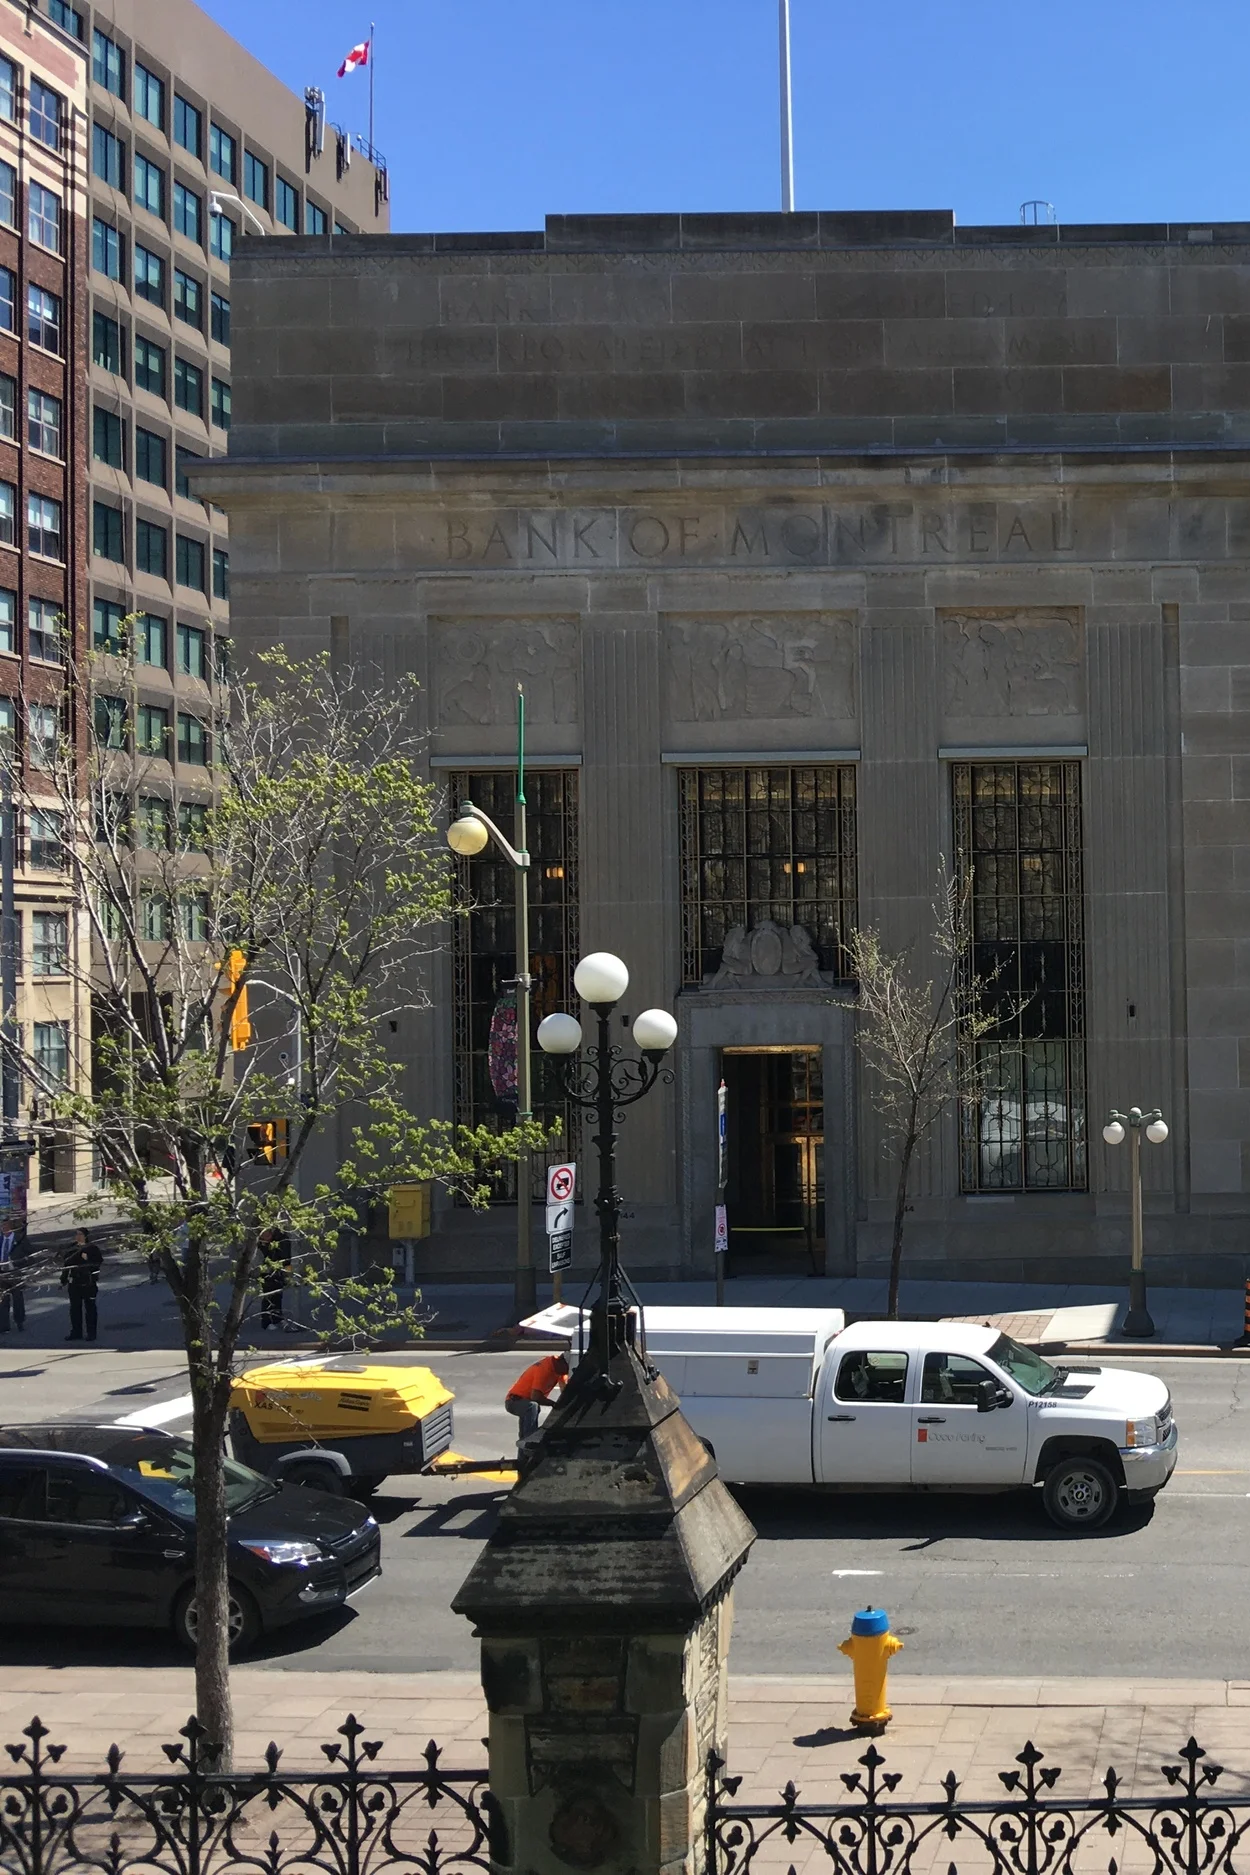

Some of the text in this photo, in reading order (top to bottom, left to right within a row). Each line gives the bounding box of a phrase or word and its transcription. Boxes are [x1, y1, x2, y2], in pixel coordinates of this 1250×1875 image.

[446, 513, 1074, 560] BANK OF MONTREAL
[254, 1401, 273, 1411] XAS
